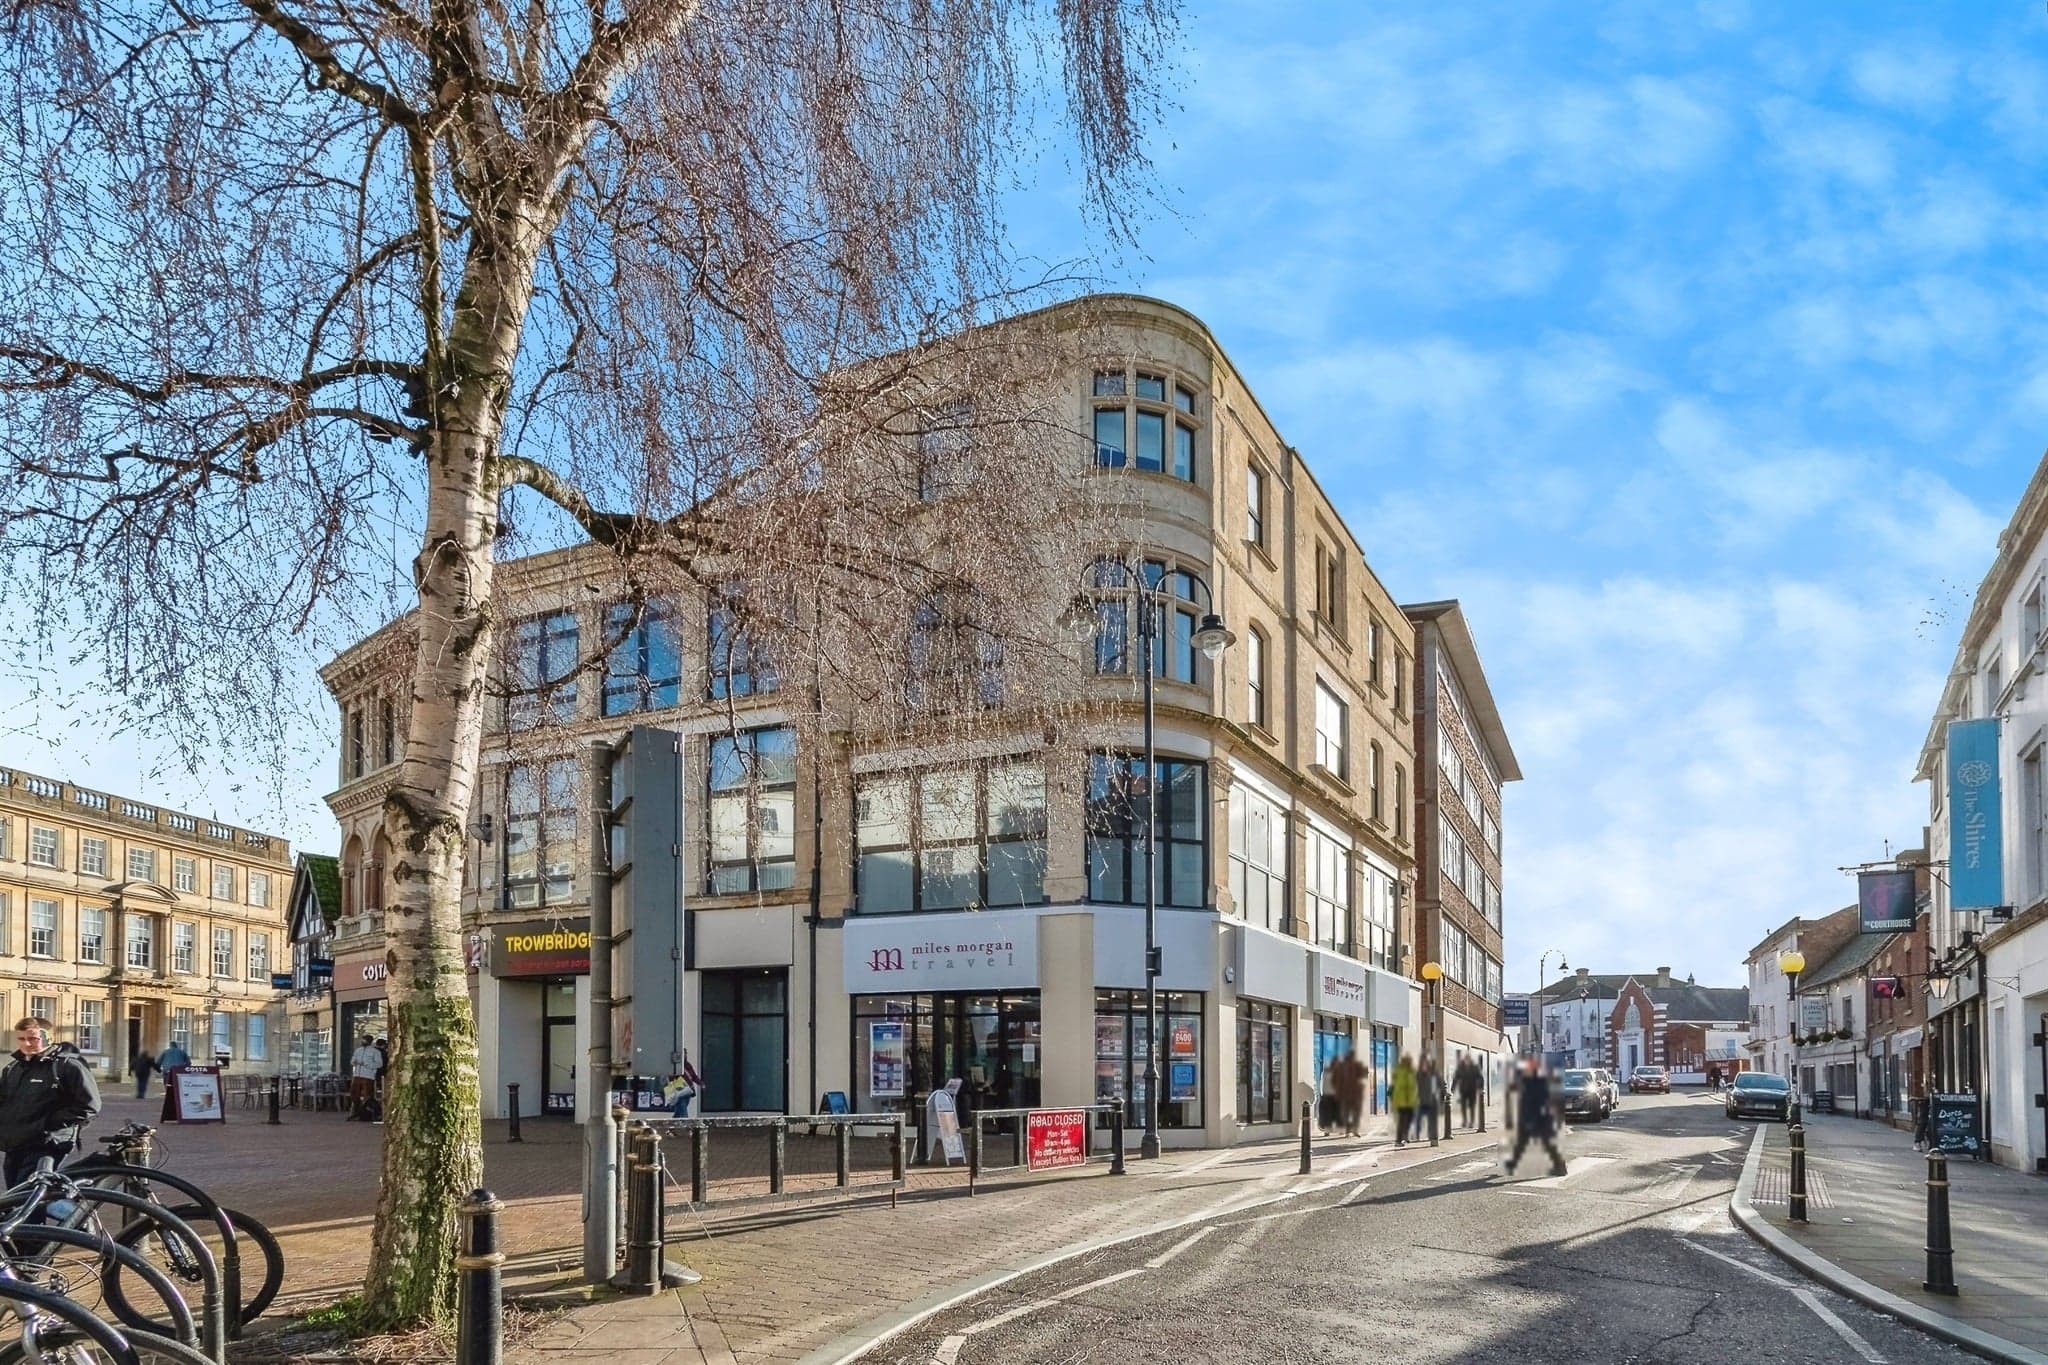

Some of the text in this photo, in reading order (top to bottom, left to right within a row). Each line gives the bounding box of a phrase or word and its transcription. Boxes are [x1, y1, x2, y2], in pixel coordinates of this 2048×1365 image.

[1965, 811, 1986, 870] Shires
[1870, 918, 1912, 929] COURTHOUSE
[912, 940, 1013, 956] miles morgan
[911, 952, 1015, 970] travel
[17, 981, 71, 993] HSBC UK
[1030, 1113, 1083, 1127] ROAD CLOSED
